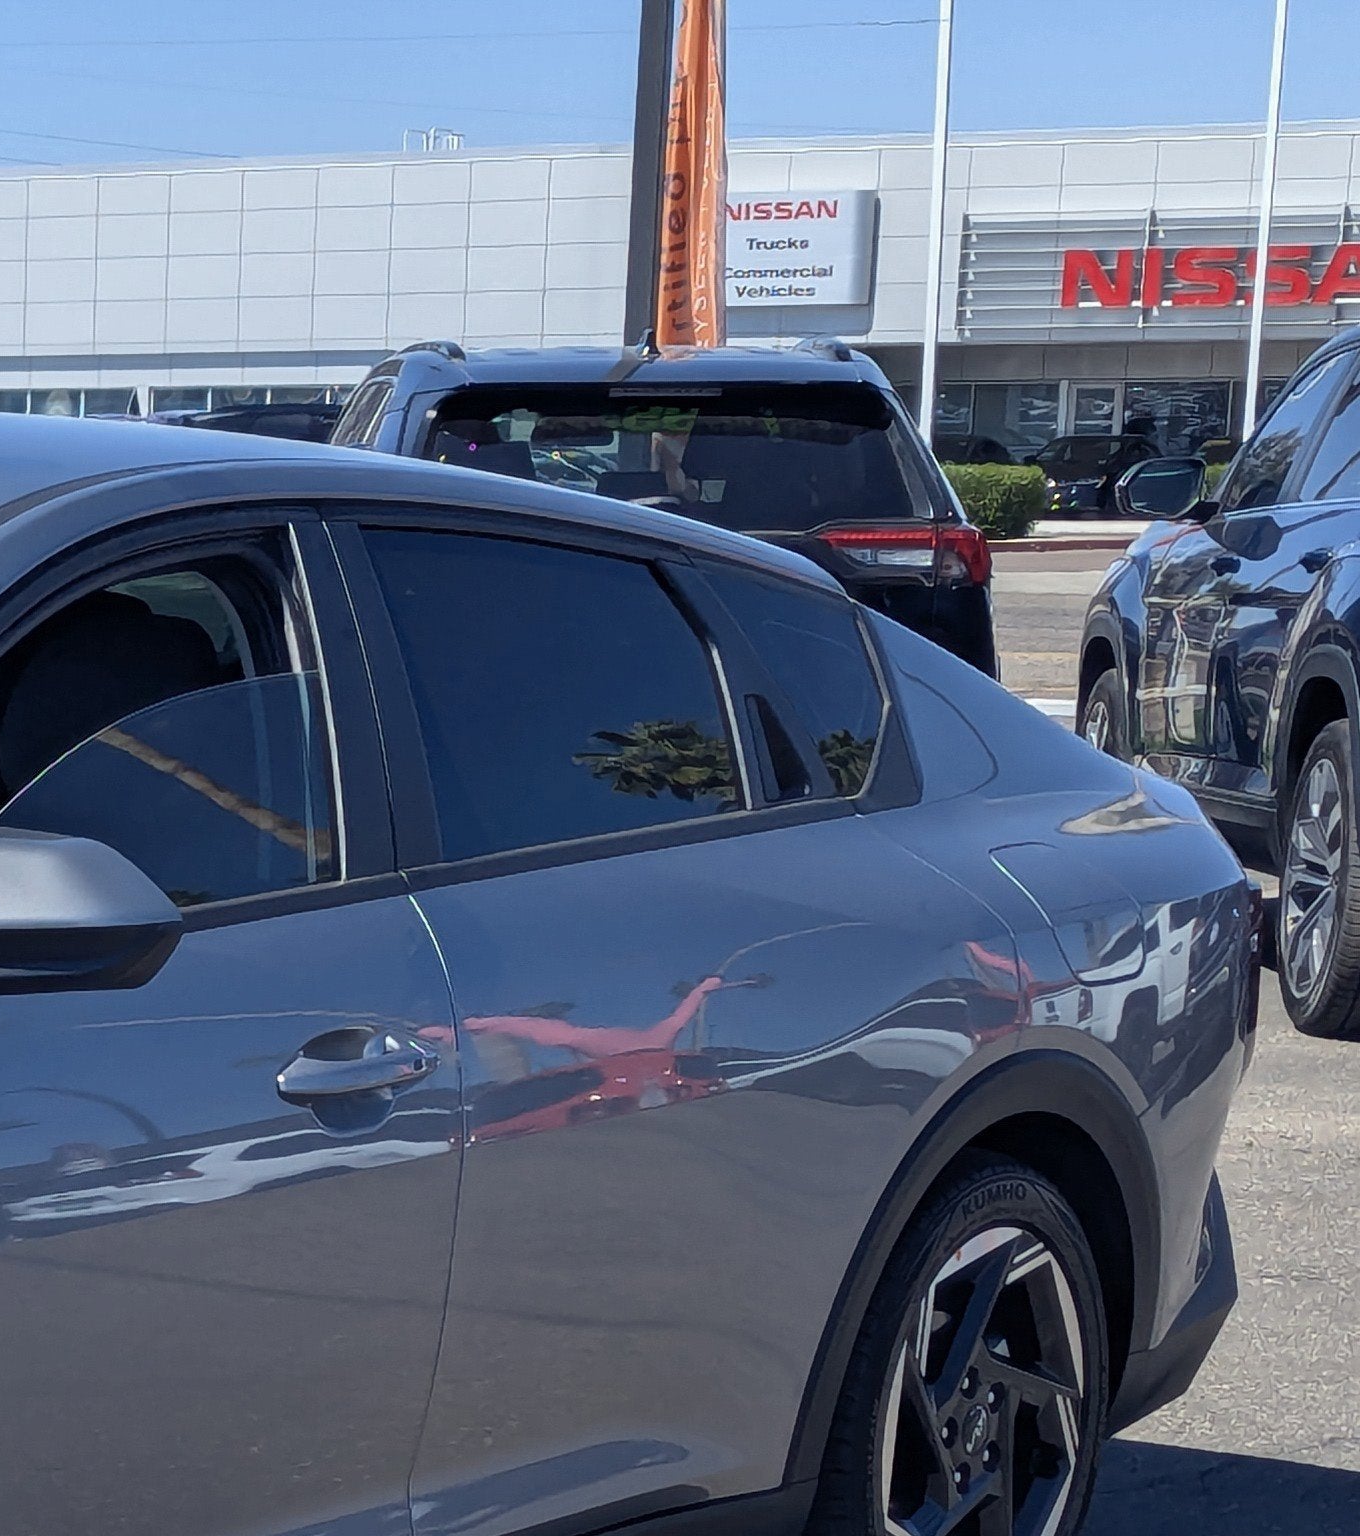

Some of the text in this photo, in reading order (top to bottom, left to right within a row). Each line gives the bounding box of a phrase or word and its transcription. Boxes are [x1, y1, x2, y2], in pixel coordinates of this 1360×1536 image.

[726, 199, 838, 221] NISSAN
[746, 237, 810, 251] Trucks
[725, 265, 834, 279] Commercial
[735, 284, 816, 298] Vehicles
